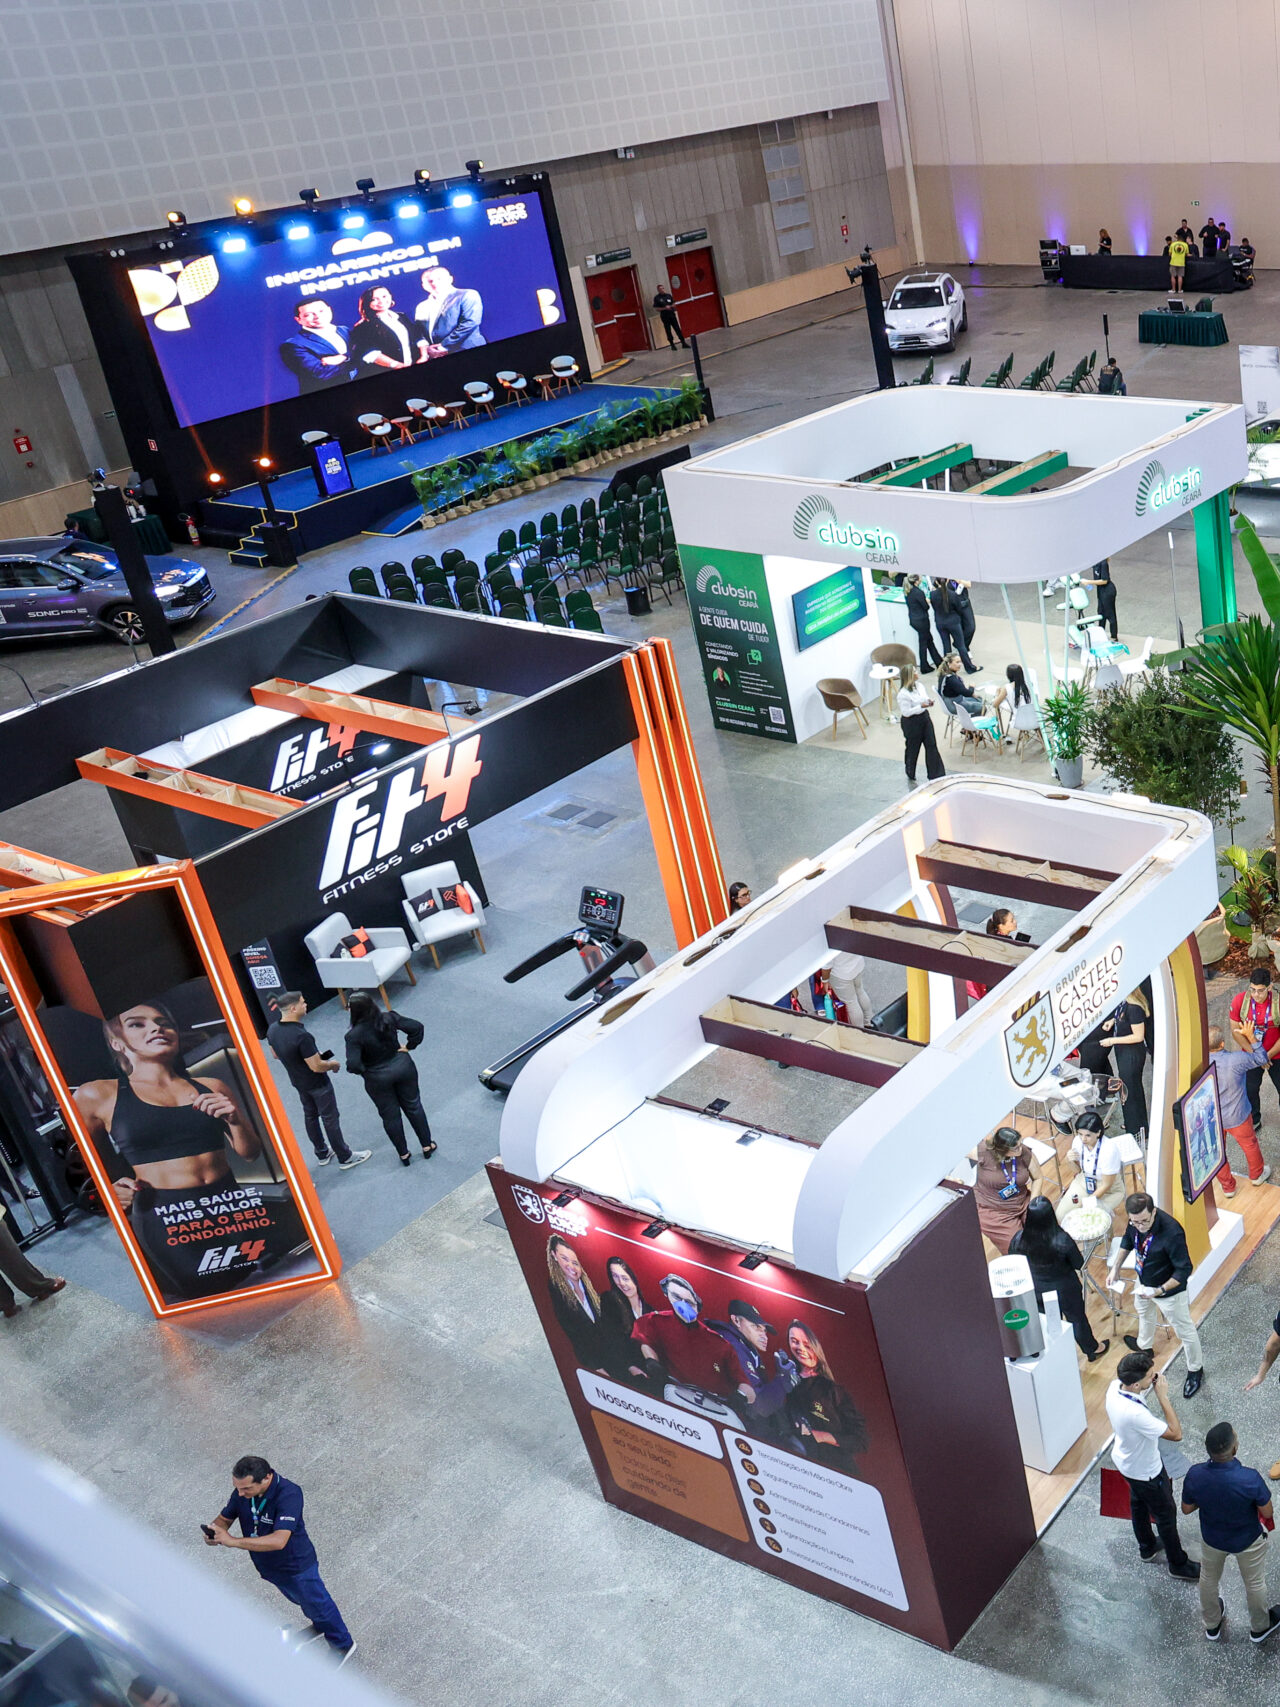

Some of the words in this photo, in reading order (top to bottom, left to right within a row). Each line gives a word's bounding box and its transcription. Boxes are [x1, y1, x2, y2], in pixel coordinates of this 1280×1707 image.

[427, 236, 462, 255] EM
[1153, 465, 1202, 509] clubsin
[1181, 487, 1202, 507] CEARÁ
[818, 522, 898, 552] clubsin
[865, 551, 900, 566] CEARÁ
[711, 583, 757, 601] clubsin
[738, 598, 760, 609] CEARÁ
[28, 609, 60, 618] SONG
[699, 613, 712, 627] DE
[712, 615, 739, 631] QUEM
[739, 619, 768, 635] CUIDA
[322, 854, 403, 904] FITNESS
[1055, 959, 1087, 994] GRUPO
[1059, 945, 1123, 1014] CASTELO
[1061, 972, 1119, 1039] BORGES
[1063, 1028, 1085, 1051] DESDE
[154, 1200, 196, 1216] MAIS
[199, 1187, 263, 1206] SAÚDE,
[162, 1209, 204, 1225] MAIS
[207, 1197, 263, 1216] VALOR
[166, 1219, 215, 1236] PARA
[217, 1215, 229, 1225] O
[233, 1207, 267, 1221] SEU
[166, 1218, 276, 1246] CONDOMÍNIO.
[595, 1386, 644, 1417] Nossos
[645, 1410, 702, 1440] serviços
